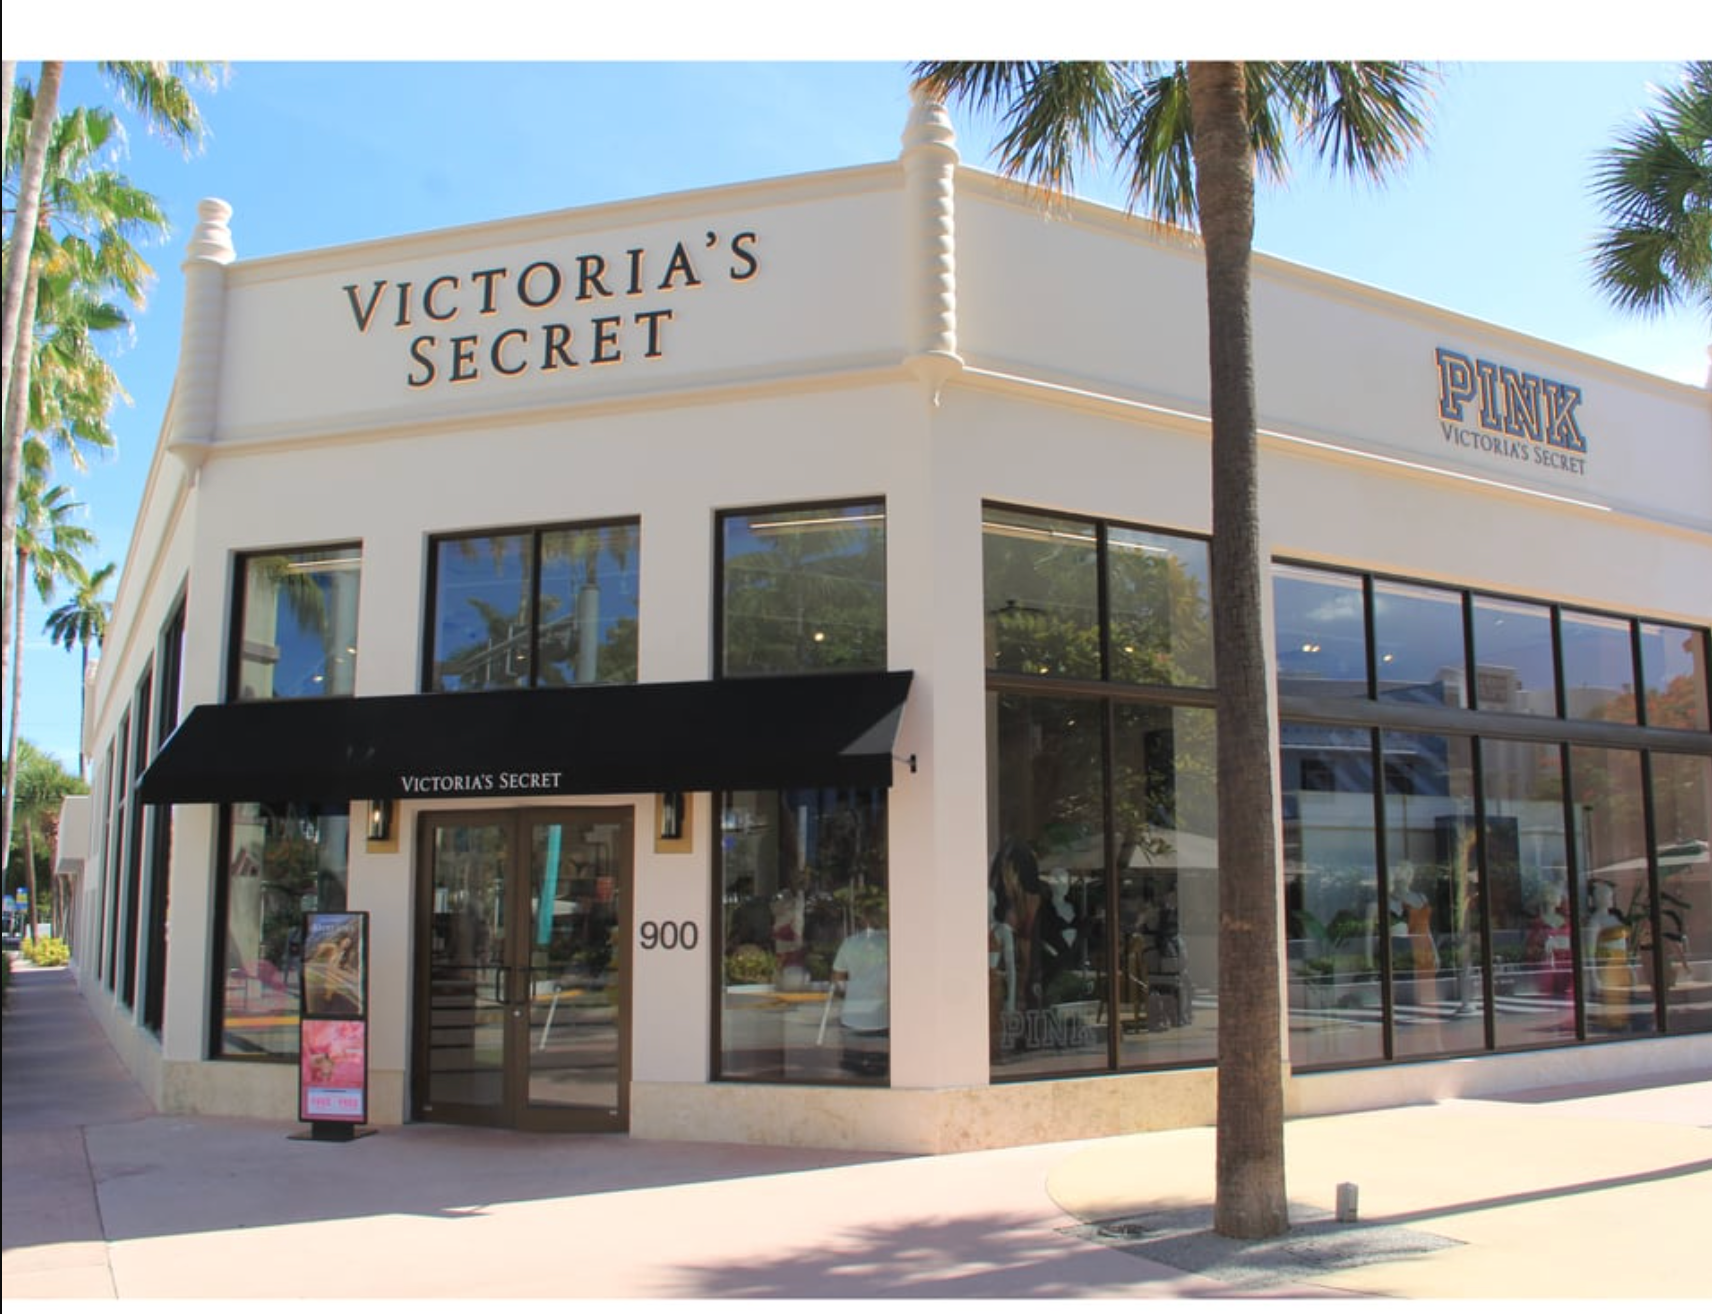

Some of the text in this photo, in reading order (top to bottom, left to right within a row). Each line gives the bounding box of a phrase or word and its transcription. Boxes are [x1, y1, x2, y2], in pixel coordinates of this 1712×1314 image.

[343, 231, 758, 332] VICTORIA'S
[407, 309, 673, 387] SECRET
[1435, 347, 1587, 453] PINK
[1440, 421, 1586, 475] VICTORIA'S SECRET
[401, 772, 562, 792] VICTORIA'S SECRET
[640, 921, 698, 950] 900
